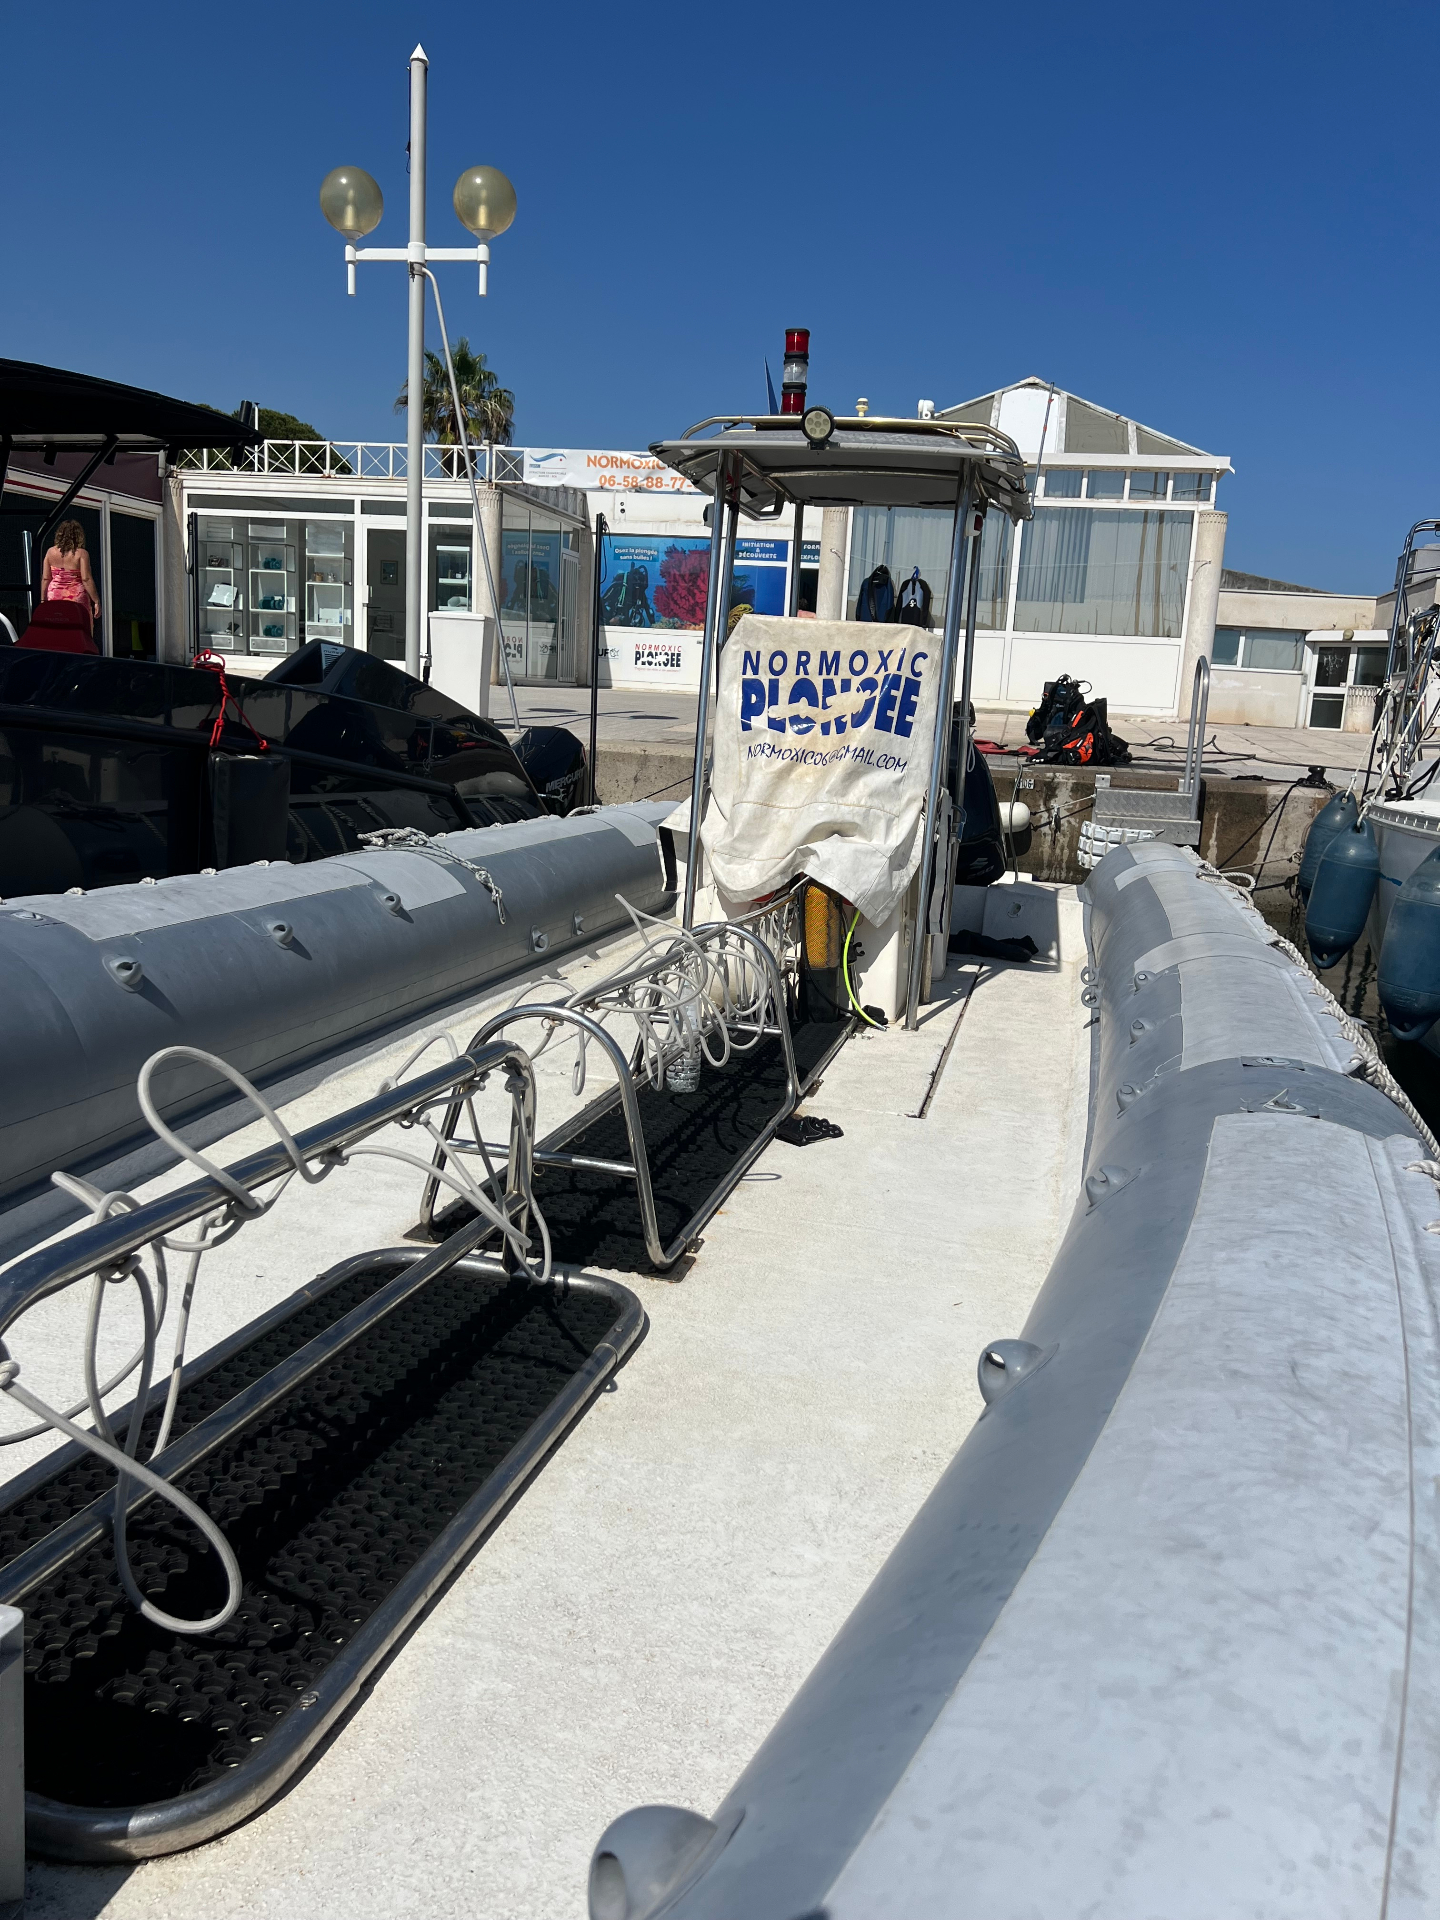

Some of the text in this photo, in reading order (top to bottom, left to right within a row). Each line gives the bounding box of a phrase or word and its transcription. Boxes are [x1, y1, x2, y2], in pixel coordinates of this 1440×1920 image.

[586, 455, 666, 470] NORMOXIC
[599, 474, 698, 489] 06-58-88-77-
[635, 643, 682, 652] NORMOXIC
[742, 648, 928, 678] NORMOXIC
